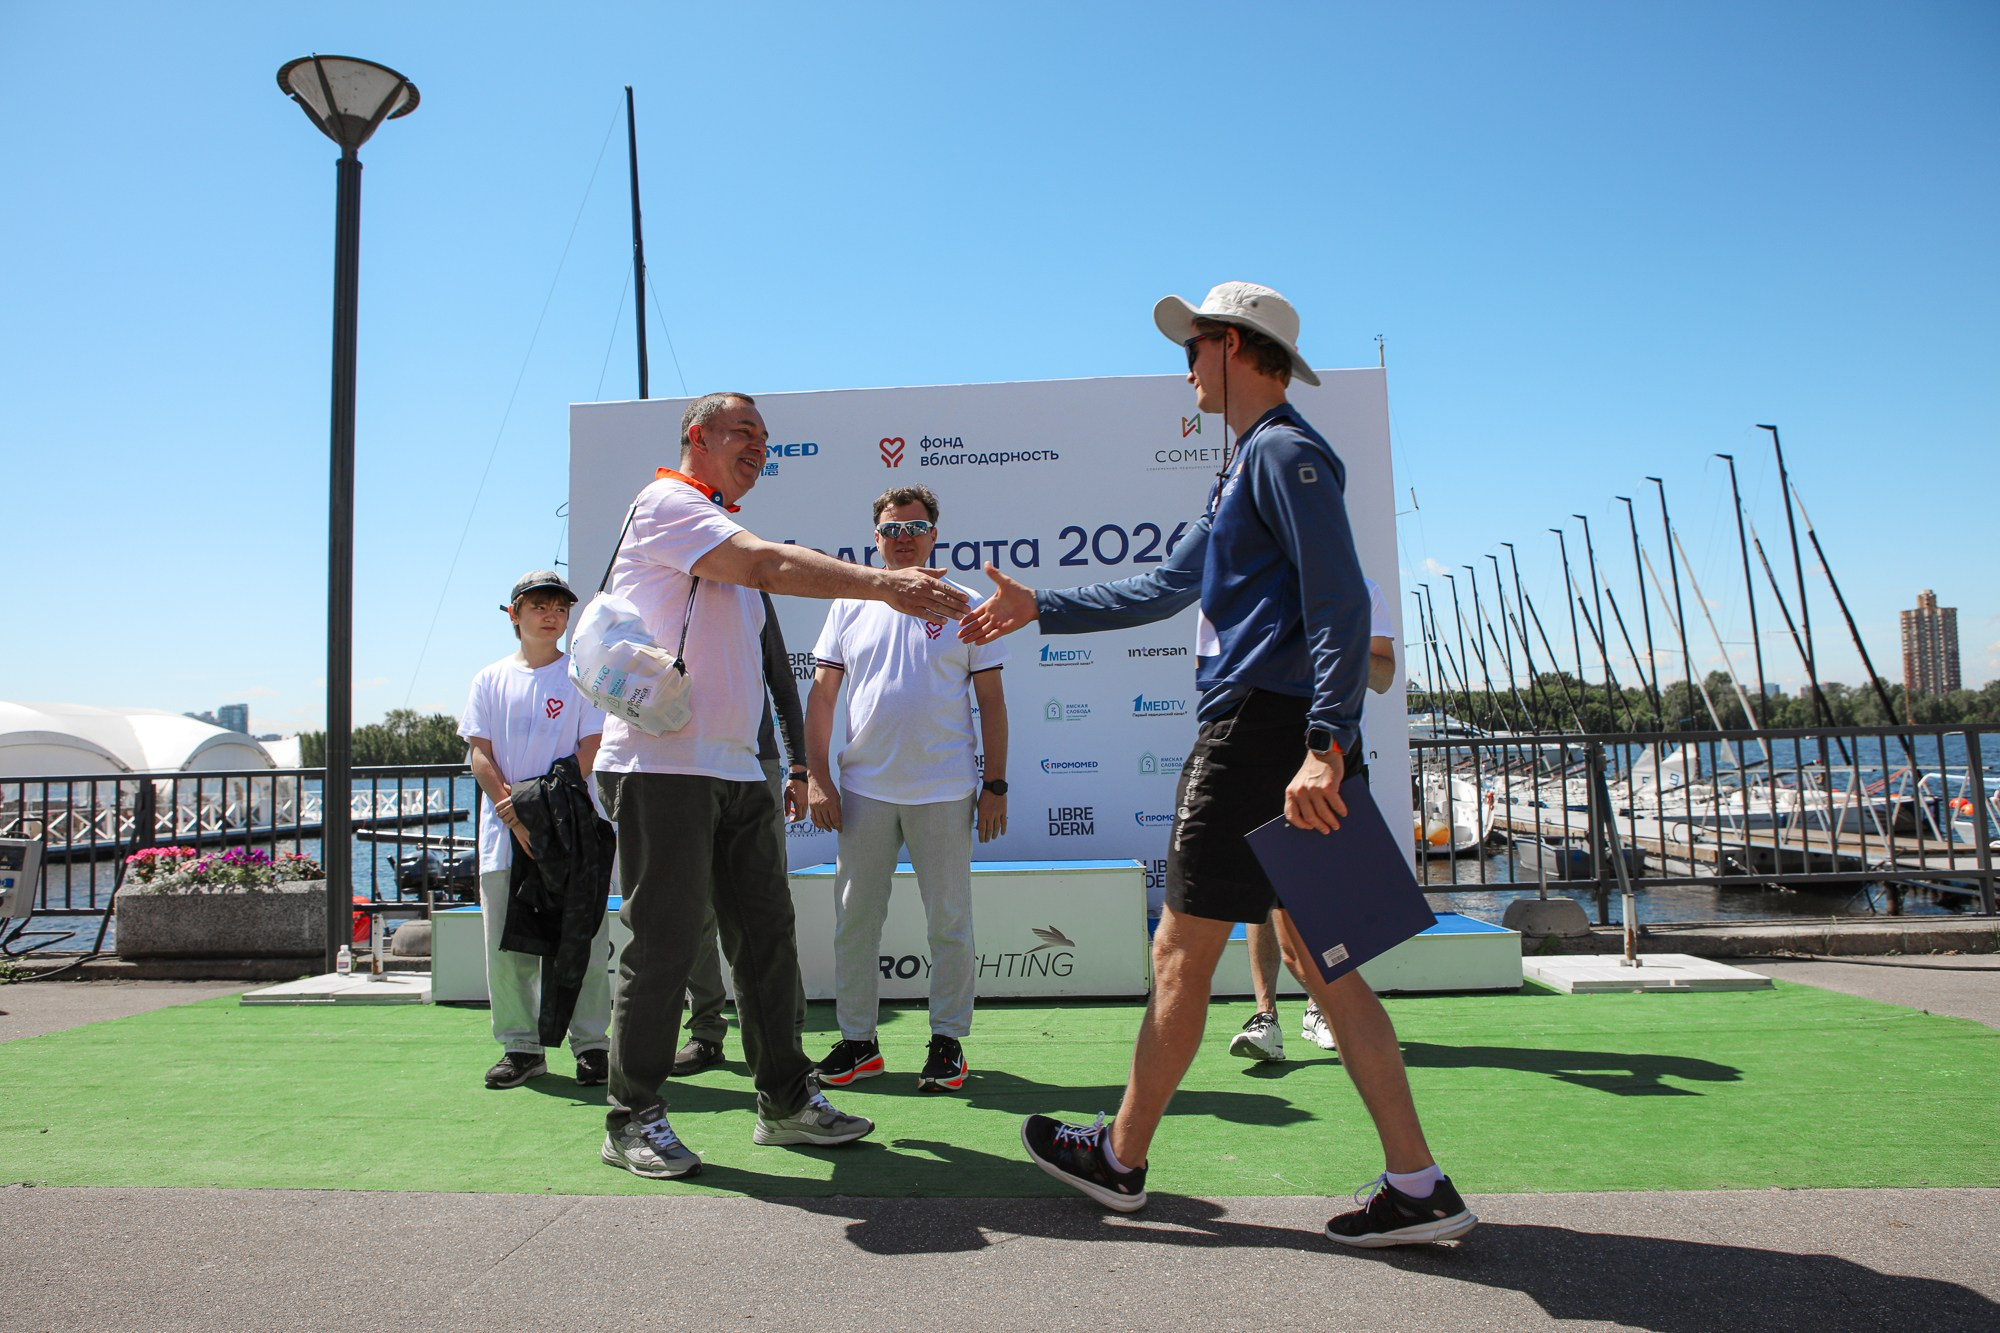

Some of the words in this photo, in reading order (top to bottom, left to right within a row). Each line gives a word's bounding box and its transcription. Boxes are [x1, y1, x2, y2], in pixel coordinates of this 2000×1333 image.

[764, 442, 819, 458] MED
[919, 435, 964, 452] фонд
[920, 449, 1060, 467] вблагодарность
[787, 652, 816, 666] BRE
[1039, 643, 1092, 662] 1MEDTV
[1127, 646, 1188, 658] intersan
[1132, 693, 1186, 712] 1MEDTV
[1048, 806, 1094, 822] LIBRE
[1049, 821, 1094, 837] DERM
[1144, 859, 1168, 874] LIB
[1146, 874, 1166, 889] DE
[879, 952, 1074, 980] ROYHTING
